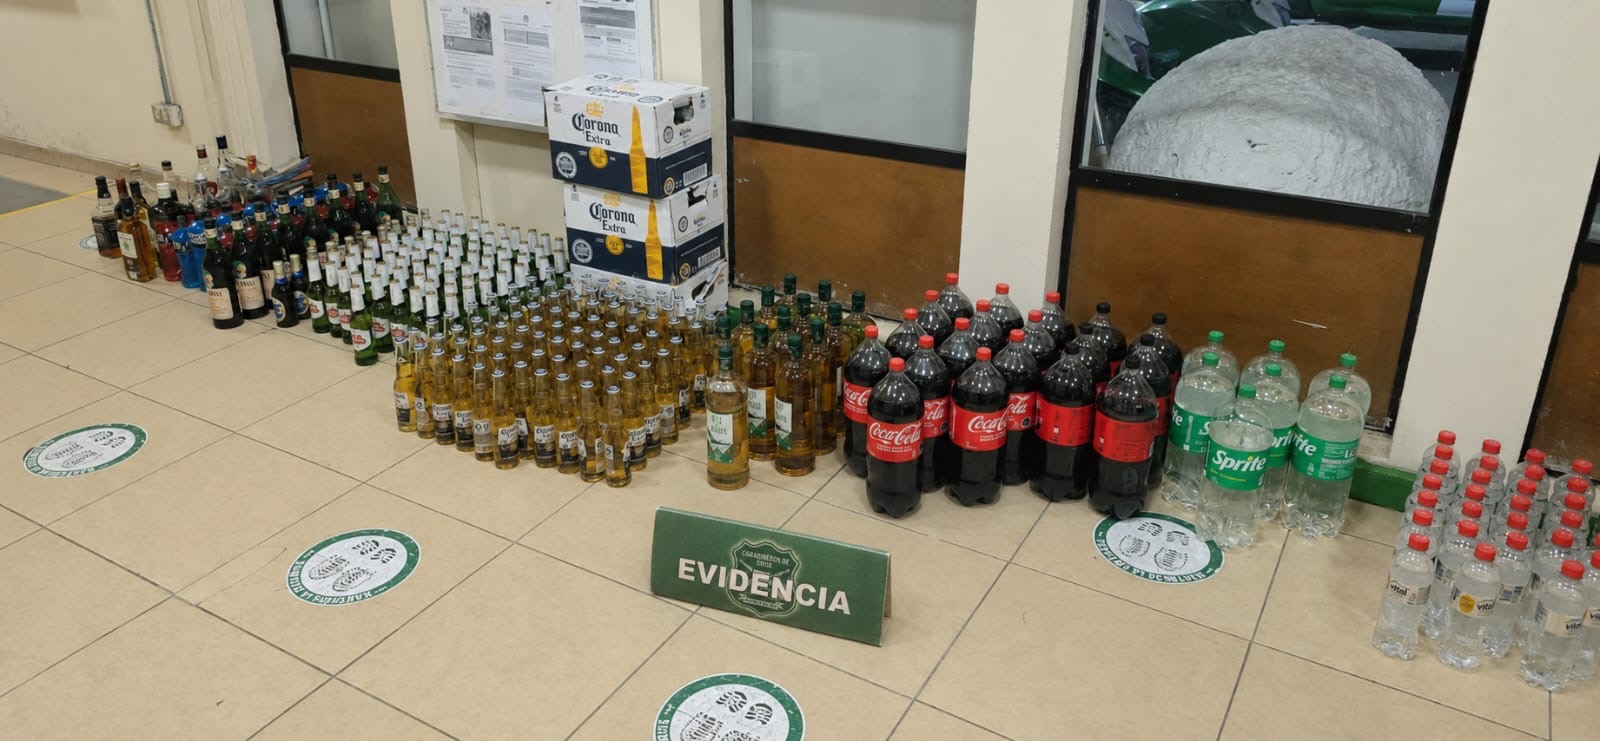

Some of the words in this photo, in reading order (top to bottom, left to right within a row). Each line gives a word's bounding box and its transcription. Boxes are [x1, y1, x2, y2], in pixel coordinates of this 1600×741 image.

[572, 112, 619, 135] Corona
[585, 131, 611, 146] Extra
[589, 202, 636, 224] Corona
[602, 221, 626, 235] Extra
[869, 422, 922, 445] Coca-Cola
[1212, 450, 1267, 472] Sprite
[741, 550, 781, 564] CARABINEROS
[781, 558, 790, 566] DE
[678, 558, 850, 615] EVIDENCIA
[1390, 583, 1408, 597] vital
